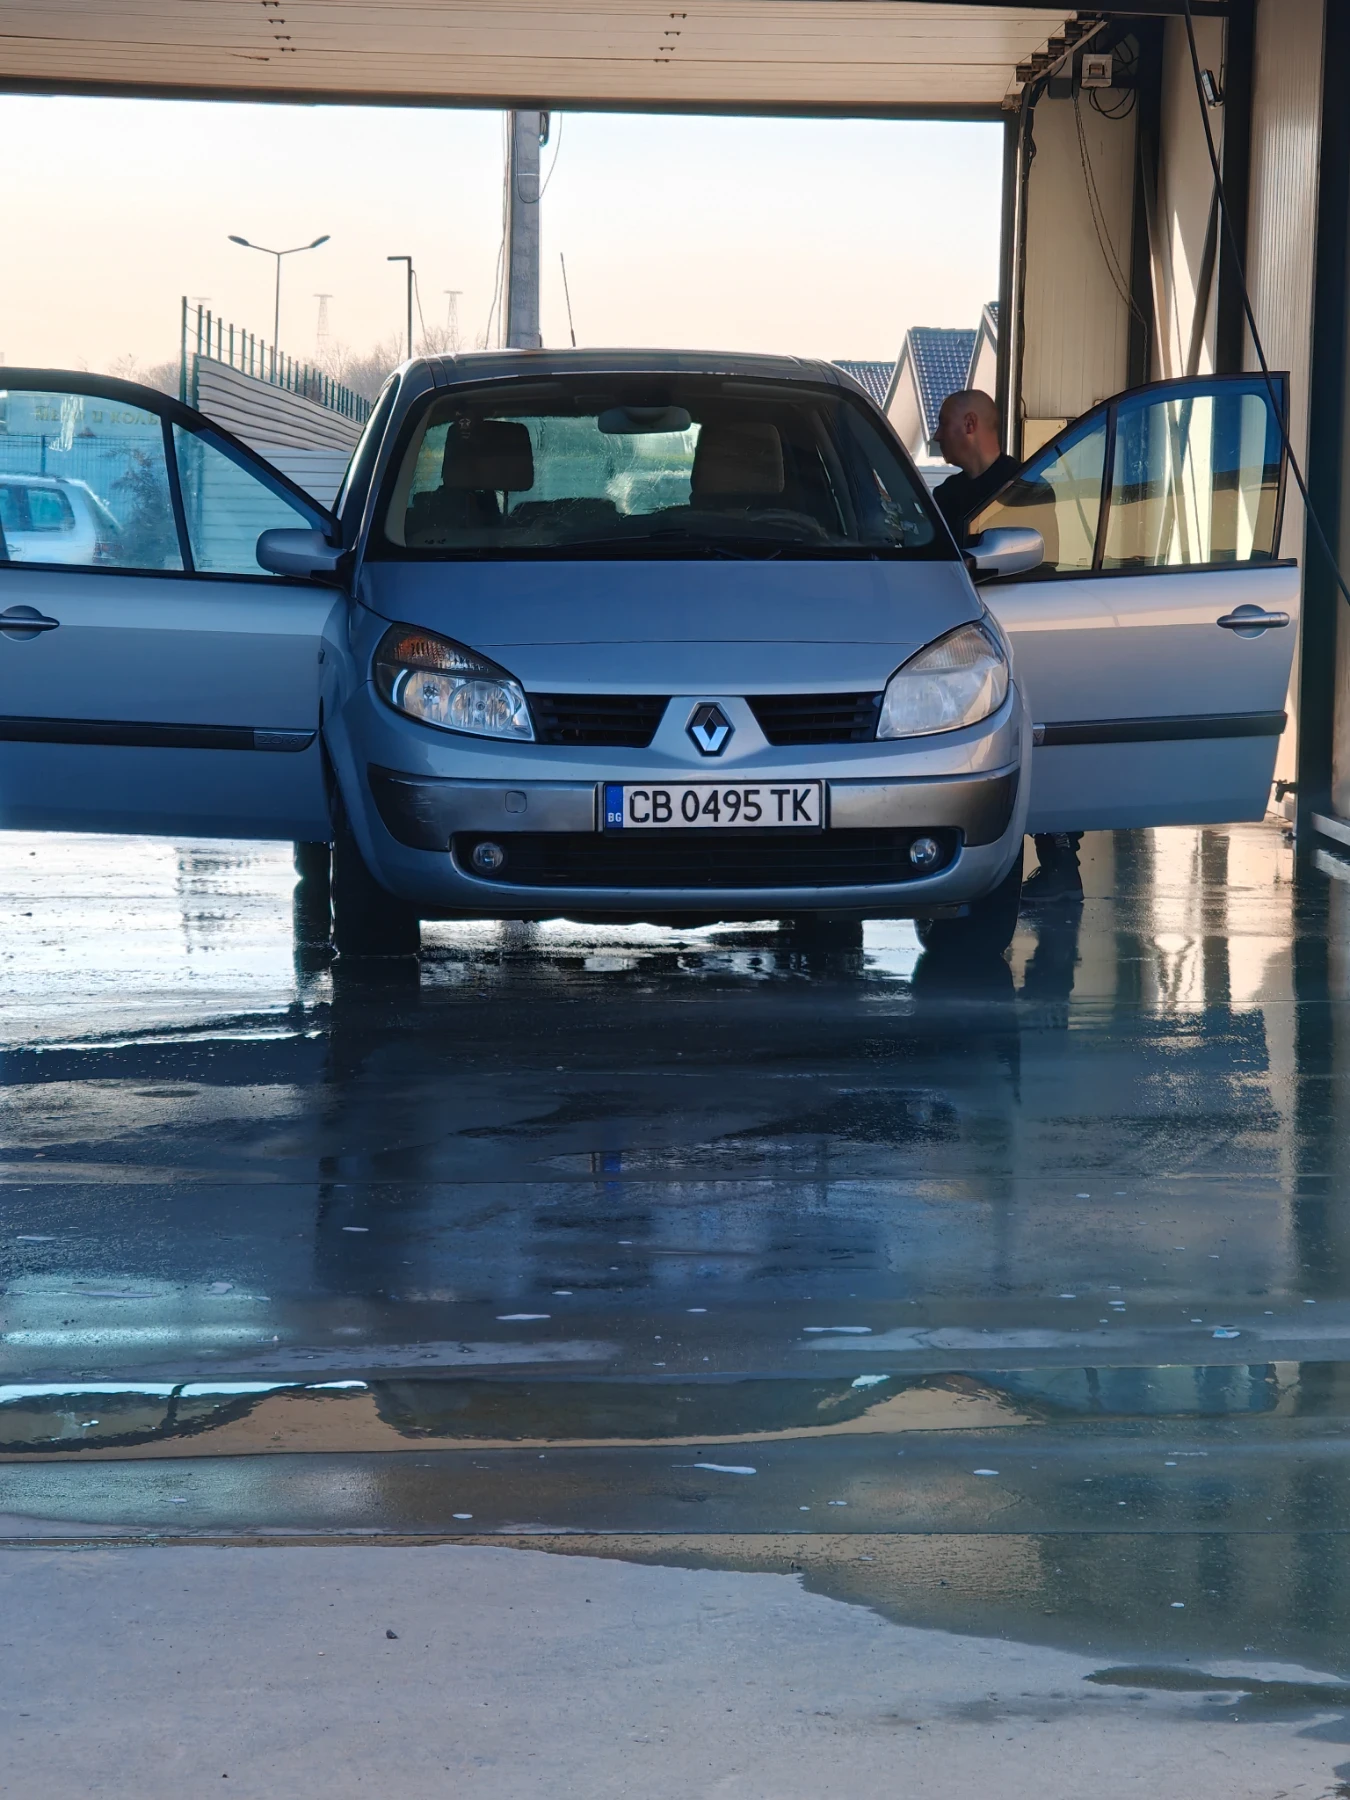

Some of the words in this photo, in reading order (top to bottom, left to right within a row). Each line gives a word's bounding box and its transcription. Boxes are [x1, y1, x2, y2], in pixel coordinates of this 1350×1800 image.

[629, 790, 673, 823] CB
[681, 789, 762, 823] 0495
[770, 788, 812, 822] TK
[608, 812, 622, 822] BG
